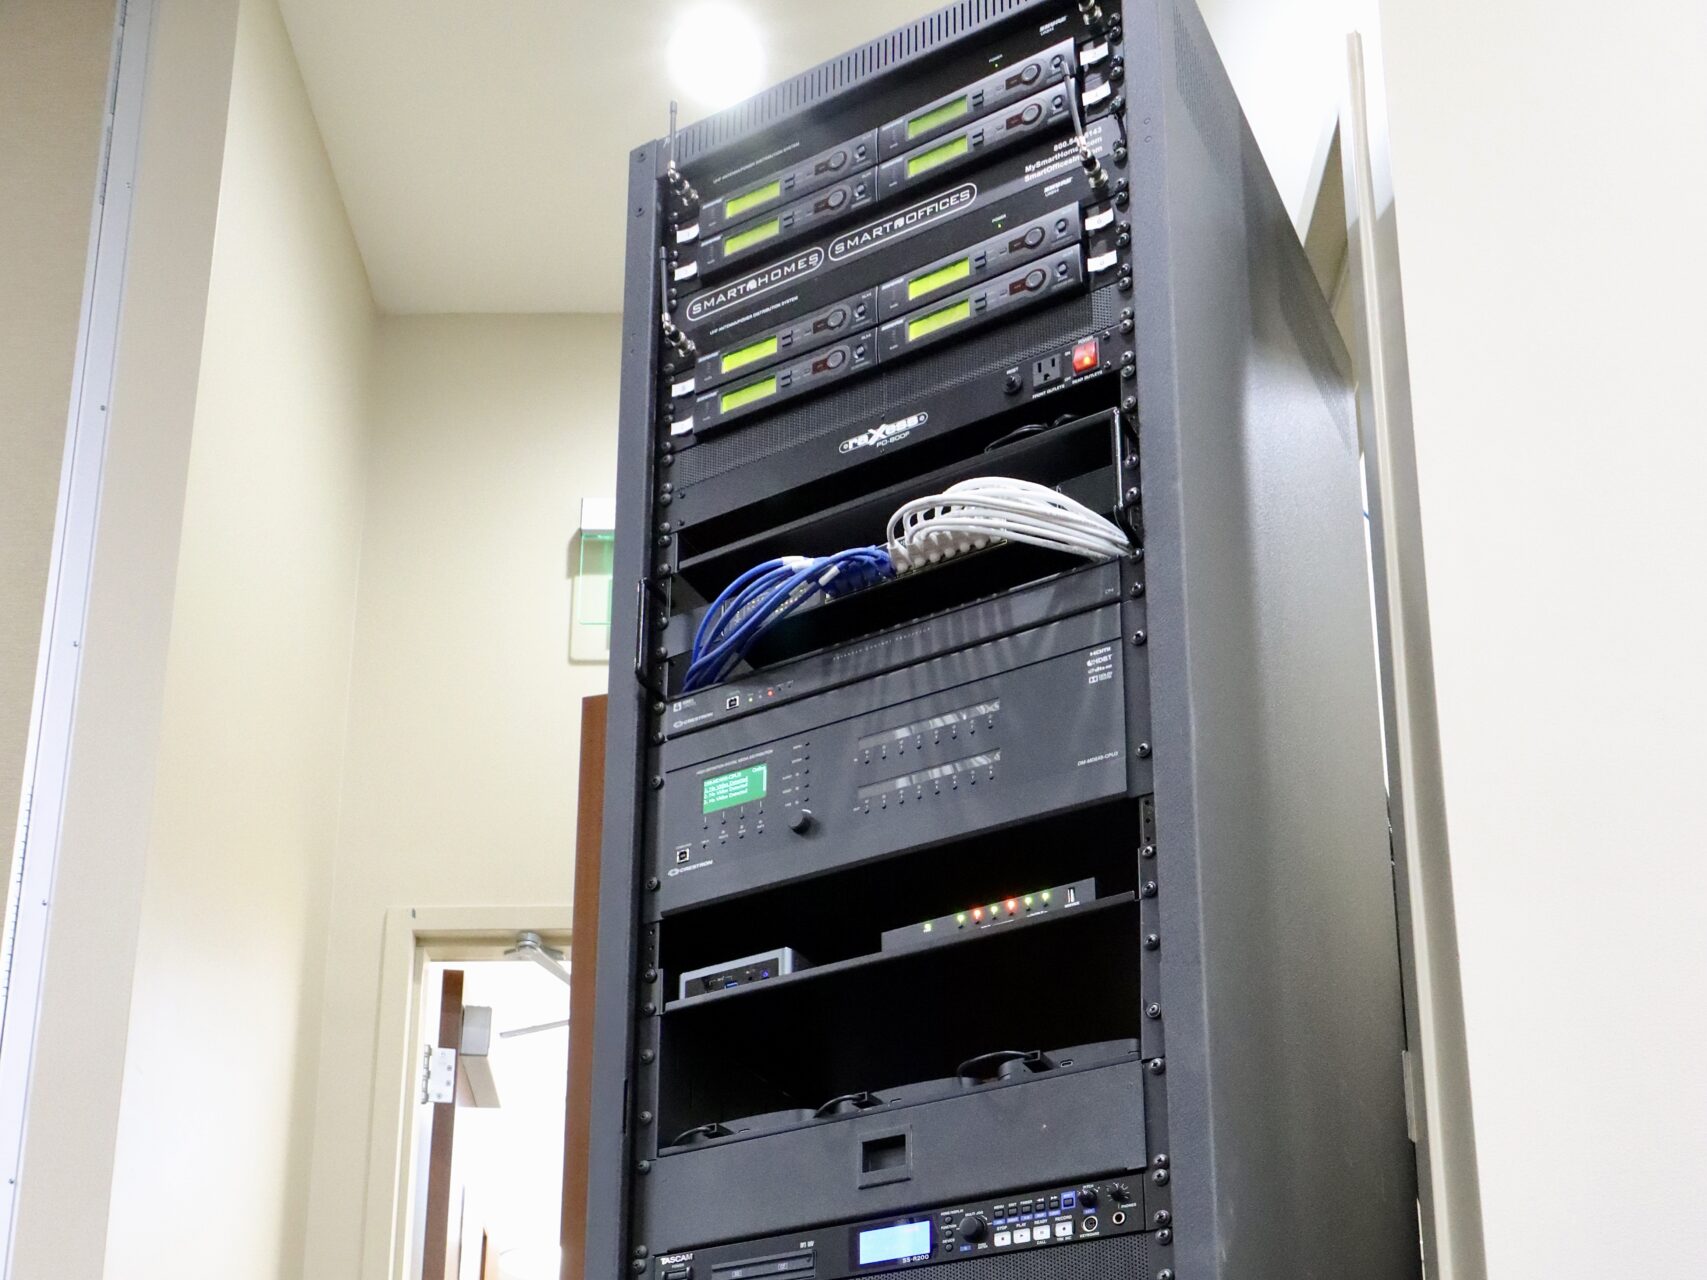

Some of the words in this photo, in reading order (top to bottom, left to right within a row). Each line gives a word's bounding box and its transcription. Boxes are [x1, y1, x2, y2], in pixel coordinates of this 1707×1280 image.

[834, 222, 896, 255] SMART
[906, 190, 970, 225] OFFICES
[692, 282, 750, 315] SMART
[757, 254, 820, 287] HOMES
[876, 430, 911, 448] PD-800F
[660, 1253, 694, 1266] TASCAM
[902, 1254, 930, 1264] SS-R200
